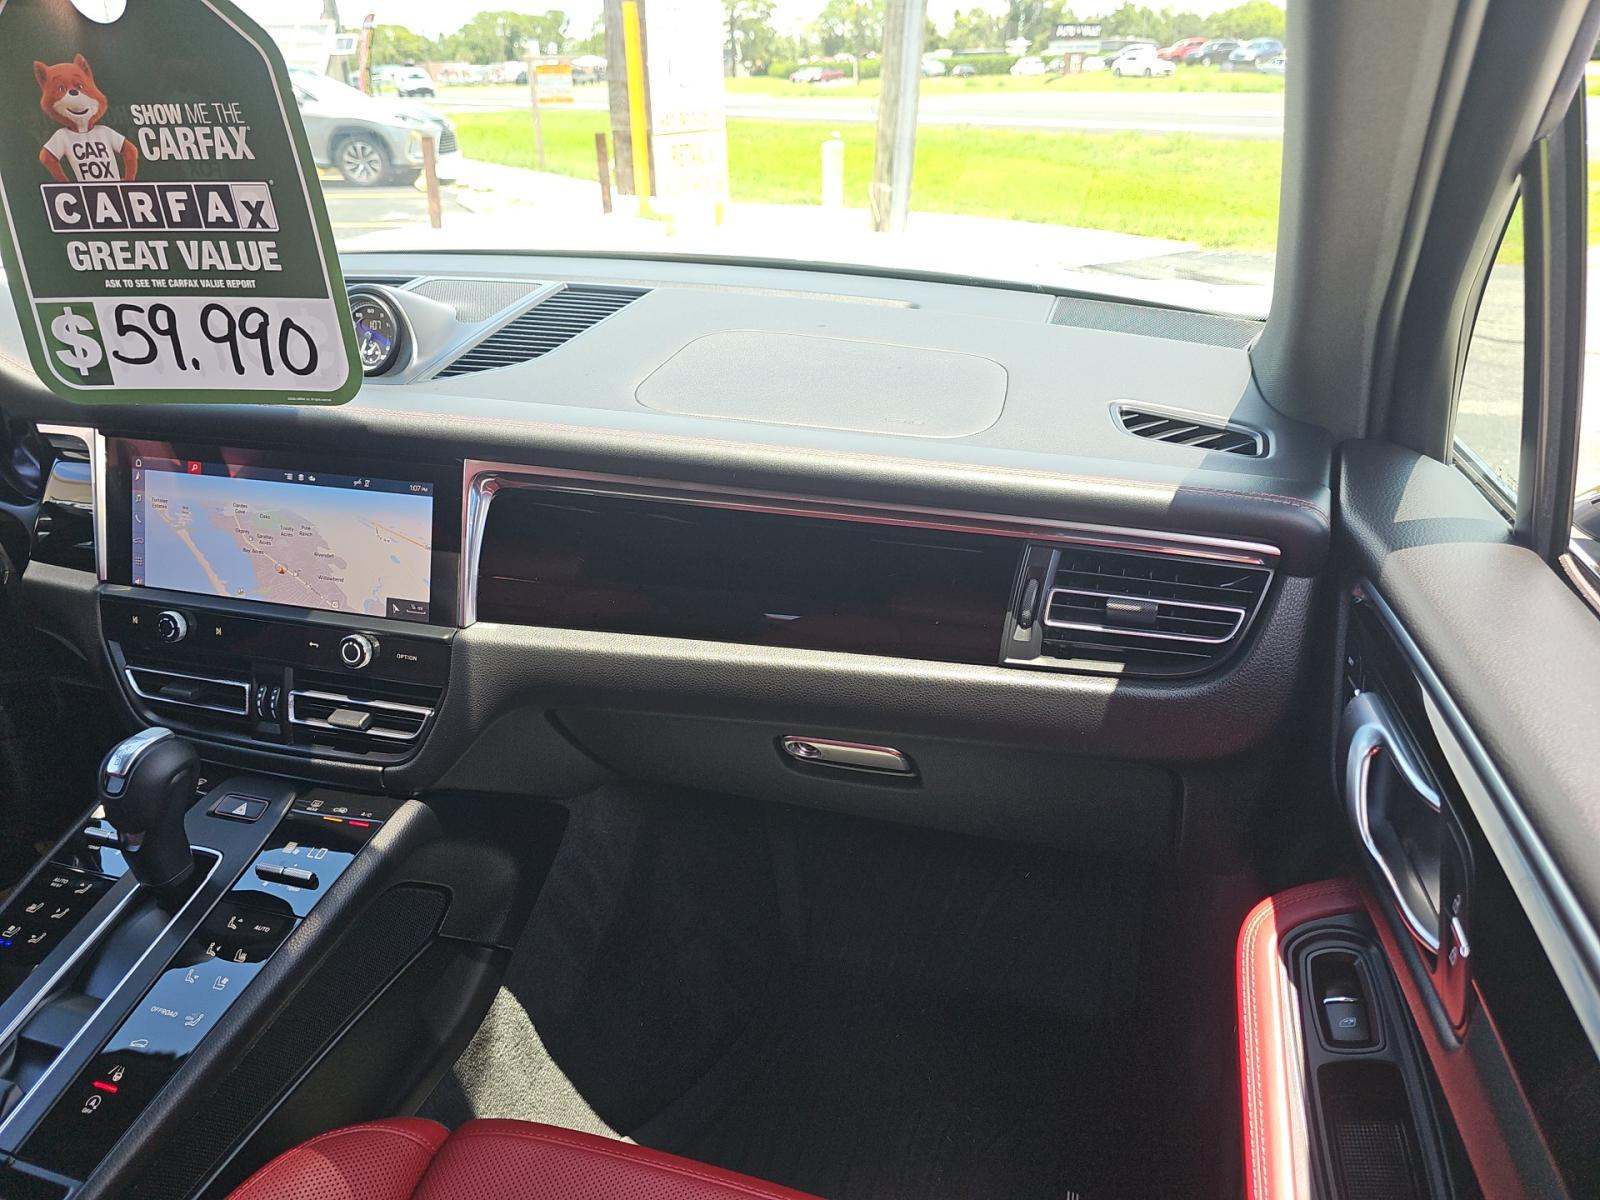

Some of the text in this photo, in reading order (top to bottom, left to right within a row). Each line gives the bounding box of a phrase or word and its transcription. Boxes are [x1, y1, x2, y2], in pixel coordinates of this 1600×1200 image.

[130, 102, 245, 126] SHOW ME THE
[72, 141, 110, 160] CAR
[138, 126, 256, 161] CARFAX
[78, 161, 115, 181] FOX
[53, 190, 272, 229] CARFAX
[66, 240, 283, 271] GREAT VALUE
[105, 278, 256, 289] ASK TO SEE THE CARFAX VALUE REPORT
[396, 653, 418, 661] OPTION
[52, 876, 70, 885] AUTO
[253, 924, 271, 933] AUTO
[150, 1005, 179, 1018] OFFROAD
